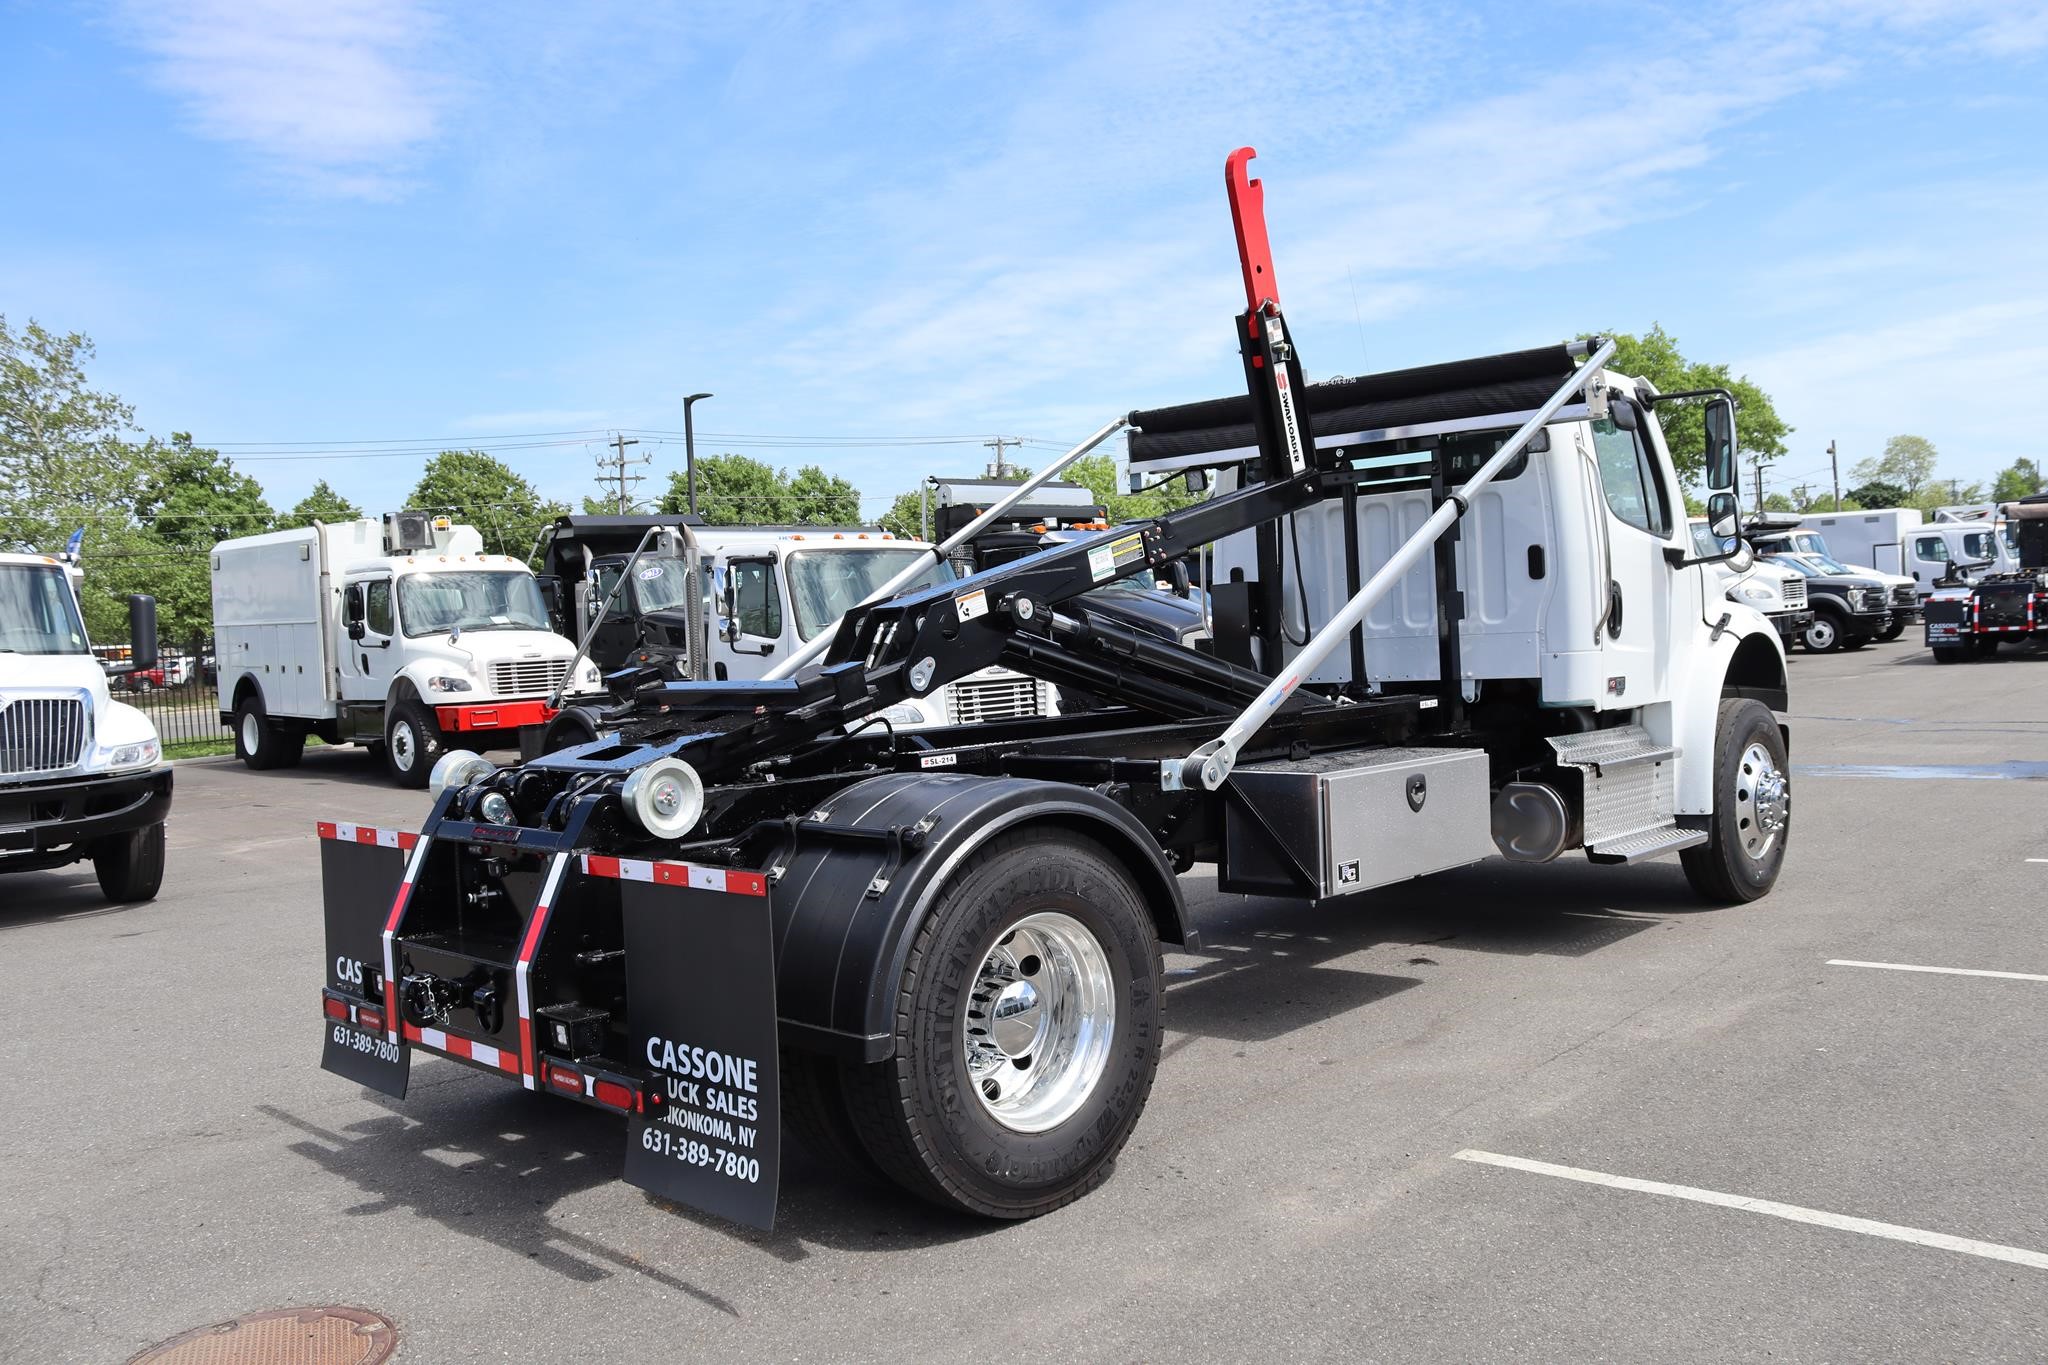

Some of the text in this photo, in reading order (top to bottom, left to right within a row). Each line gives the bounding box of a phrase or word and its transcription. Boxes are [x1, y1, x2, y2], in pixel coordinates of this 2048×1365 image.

[1281, 392, 1300, 462] SWAPLOADER
[930, 756, 953, 765] SL-214
[333, 1025, 399, 1063] 631-389-7800
[646, 1036, 758, 1093] CASSONE
[667, 1077, 758, 1121] UCK SALES
[657, 1105, 757, 1148] NKONKOMA, NY
[642, 1127, 759, 1183] 631-389-7800
